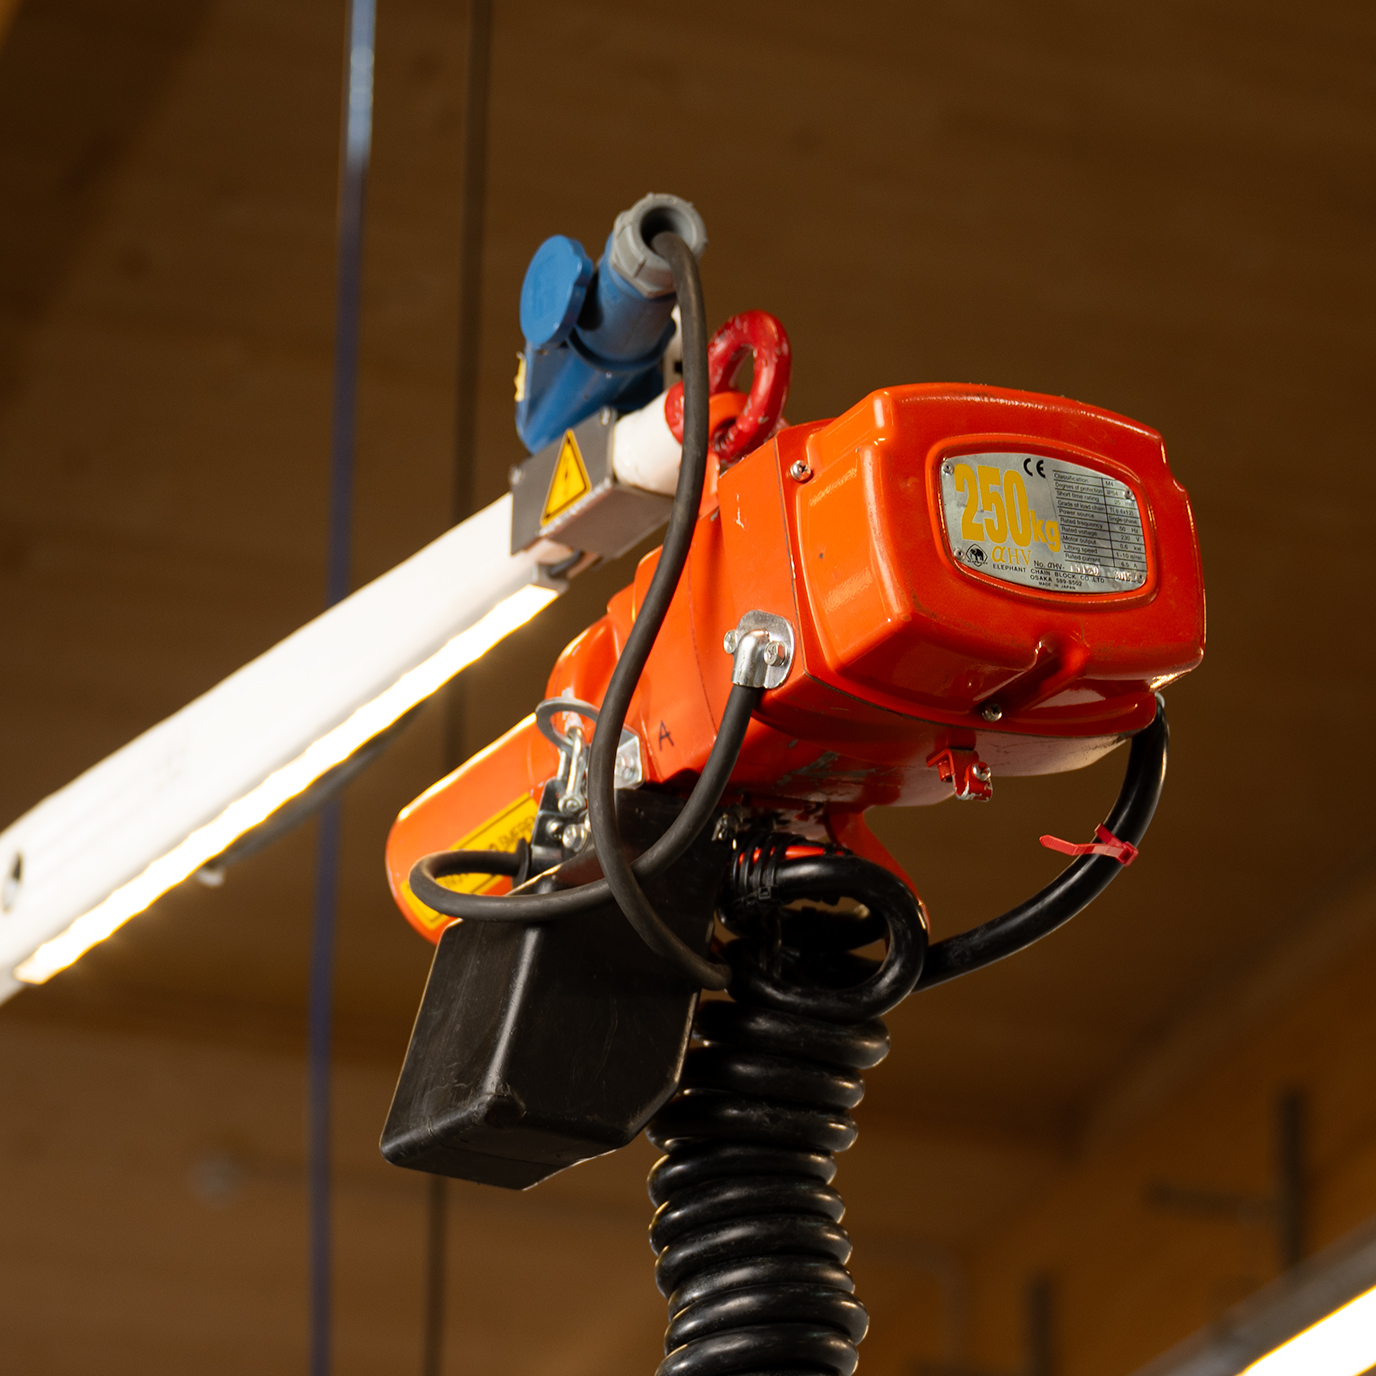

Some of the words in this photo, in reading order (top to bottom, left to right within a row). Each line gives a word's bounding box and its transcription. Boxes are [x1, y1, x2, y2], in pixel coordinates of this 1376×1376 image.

[1023, 458, 1046, 478] CE
[1084, 495, 1100, 503] rating
[1057, 500, 1075, 508] Grade
[1059, 508, 1076, 516] Power
[1060, 517, 1076, 525] Rated
[1077, 520, 1103, 529] frequency
[1065, 553, 1081, 561] Rated
[992, 563, 1026, 573] ELEPHANT
[1030, 568, 1051, 576] CHAIN
[1054, 571, 1077, 579] BLOCK
[1030, 574, 1052, 582] OSAKA
[658, 720, 674, 752] A
